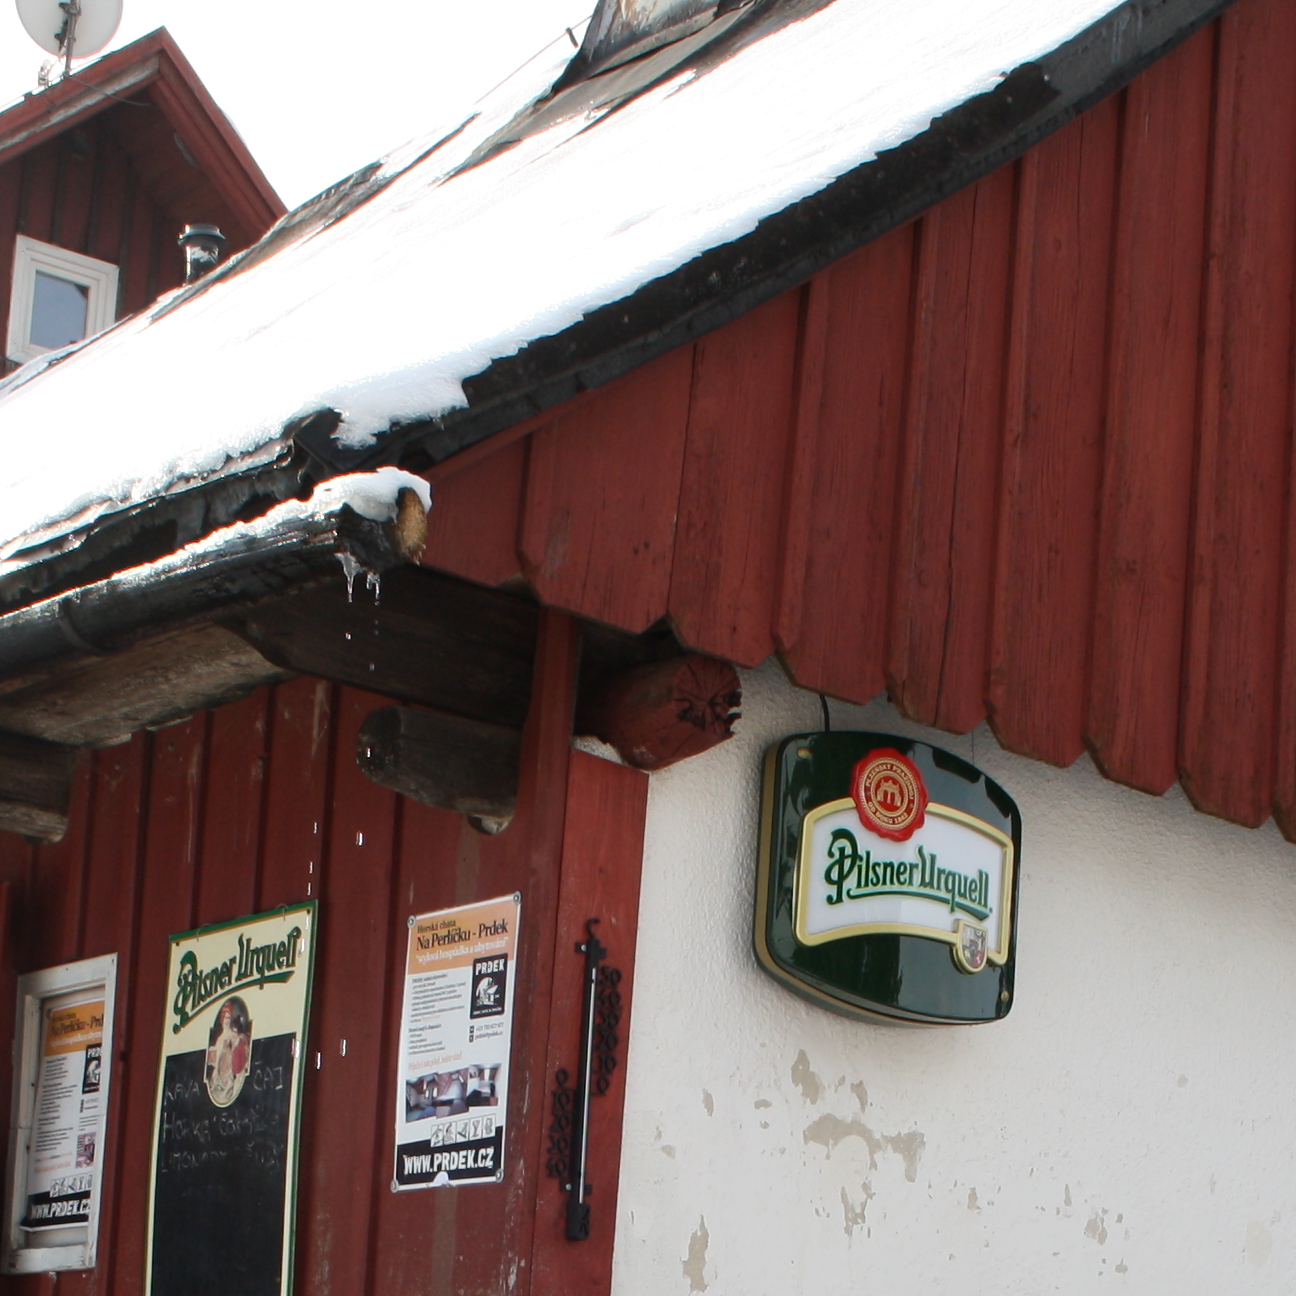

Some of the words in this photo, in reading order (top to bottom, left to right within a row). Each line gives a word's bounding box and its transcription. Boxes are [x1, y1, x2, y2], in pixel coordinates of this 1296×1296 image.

[823, 827, 920, 906] Pilsner
[916, 844, 990, 914] Urquell
[416, 935, 431, 951] Na
[478, 918, 509, 939] Prdek
[172, 950, 237, 1035] Pilsner
[234, 925, 302, 991] Urquell
[475, 958, 505, 976] PRDEK
[403, 1146, 495, 1176] WWW.PRDEK.CZ
